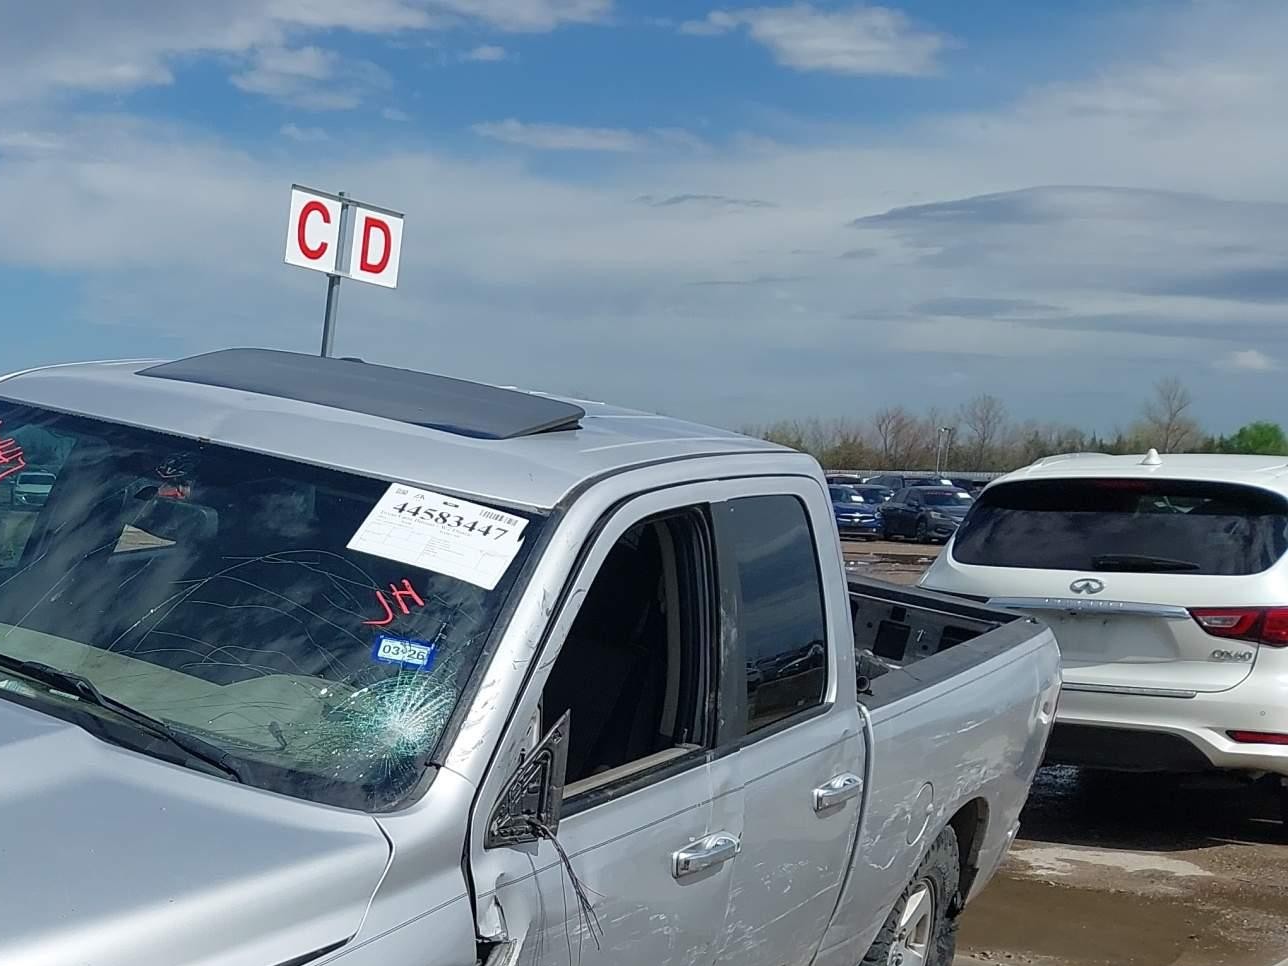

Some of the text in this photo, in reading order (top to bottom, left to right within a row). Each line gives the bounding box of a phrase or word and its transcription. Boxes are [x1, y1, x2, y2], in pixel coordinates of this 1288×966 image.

[298, 200, 392, 274] C D
[392, 501, 509, 541] 44583447
